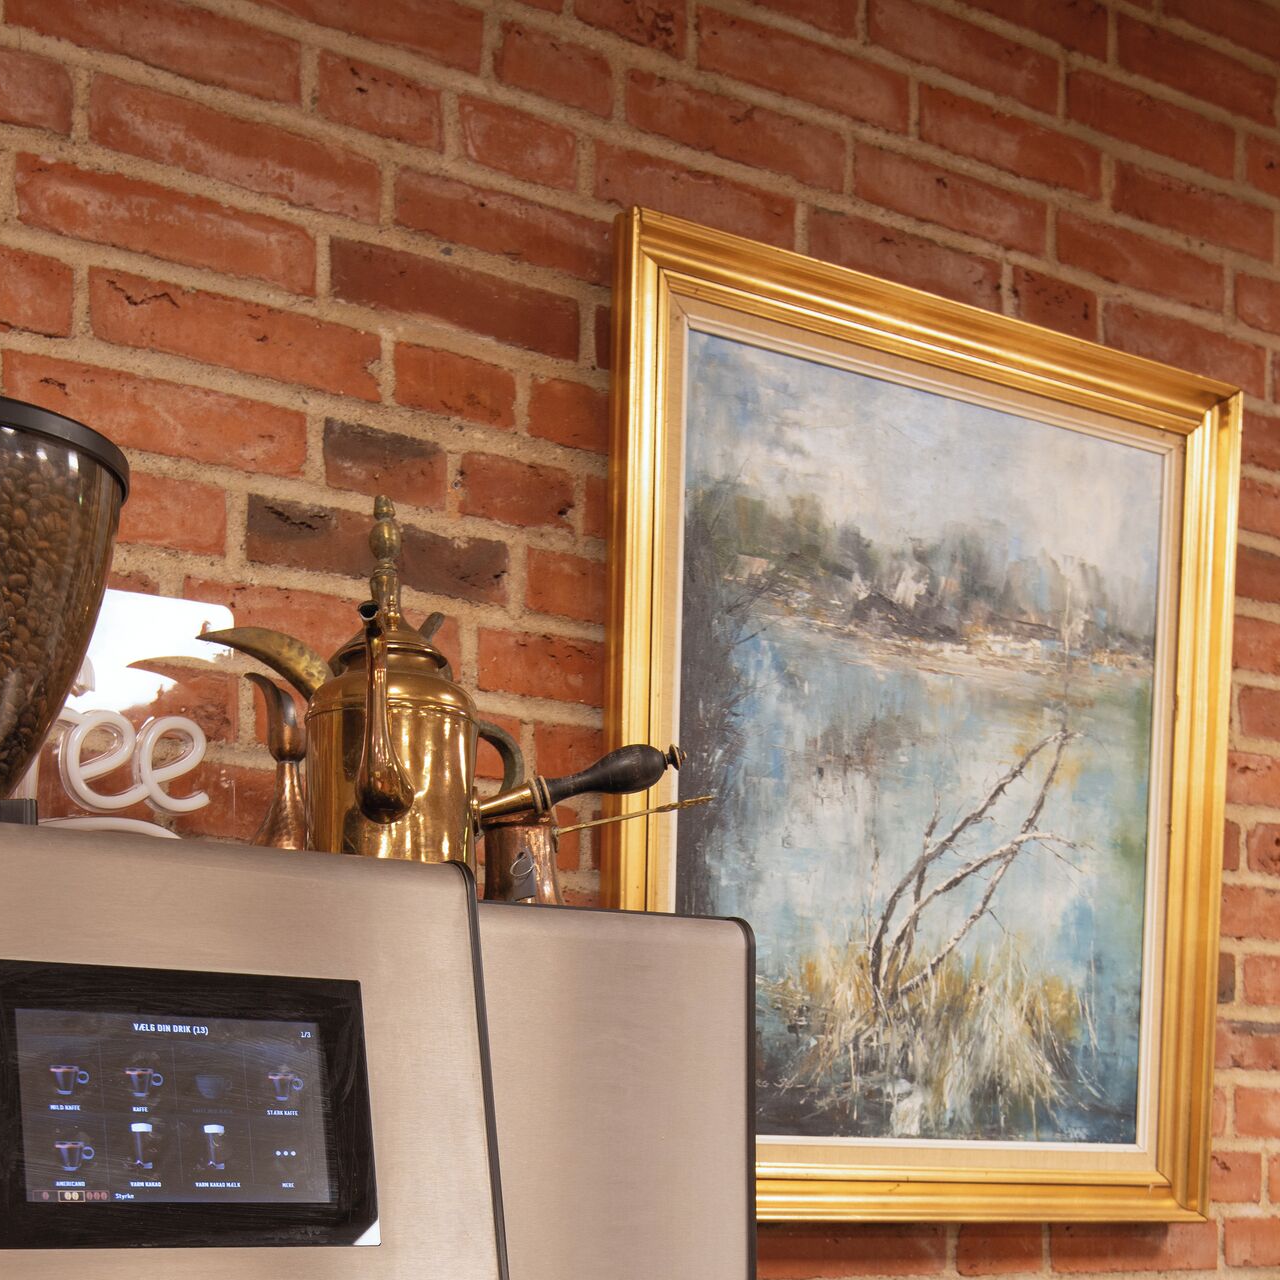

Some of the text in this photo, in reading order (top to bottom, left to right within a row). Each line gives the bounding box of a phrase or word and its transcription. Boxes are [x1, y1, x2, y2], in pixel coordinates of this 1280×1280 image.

[157, 1024, 171, 1033] DIN
[173, 1025, 191, 1033] DRIK
[193, 1026, 209, 1036] (13)
